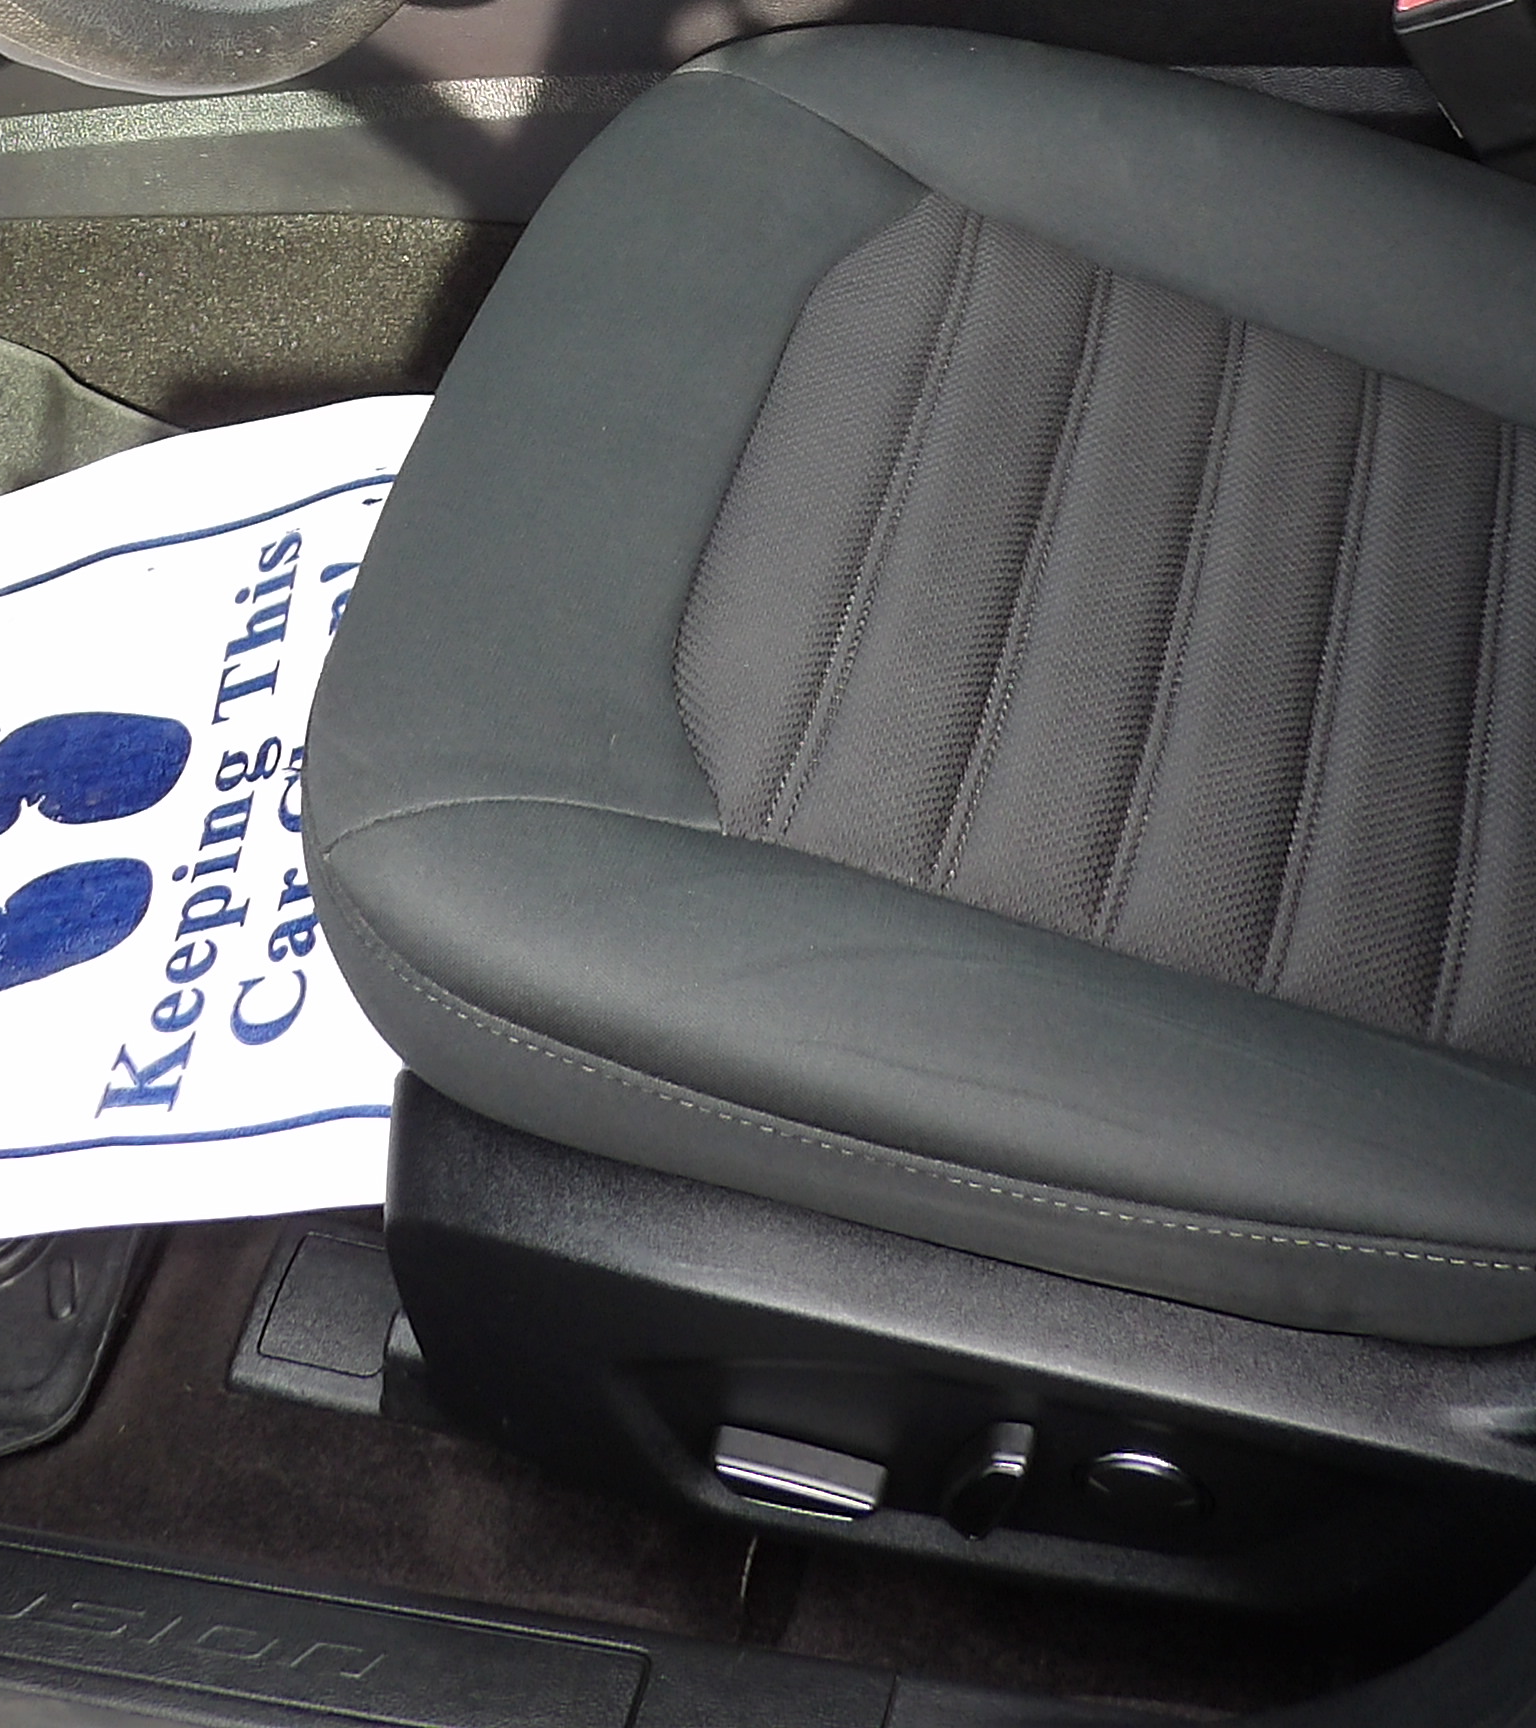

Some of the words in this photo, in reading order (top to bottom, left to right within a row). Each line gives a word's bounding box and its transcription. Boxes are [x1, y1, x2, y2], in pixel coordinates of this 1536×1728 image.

[94, 734, 283, 1119] Keeping
[210, 528, 303, 728] This
[230, 866, 323, 1048] Car
